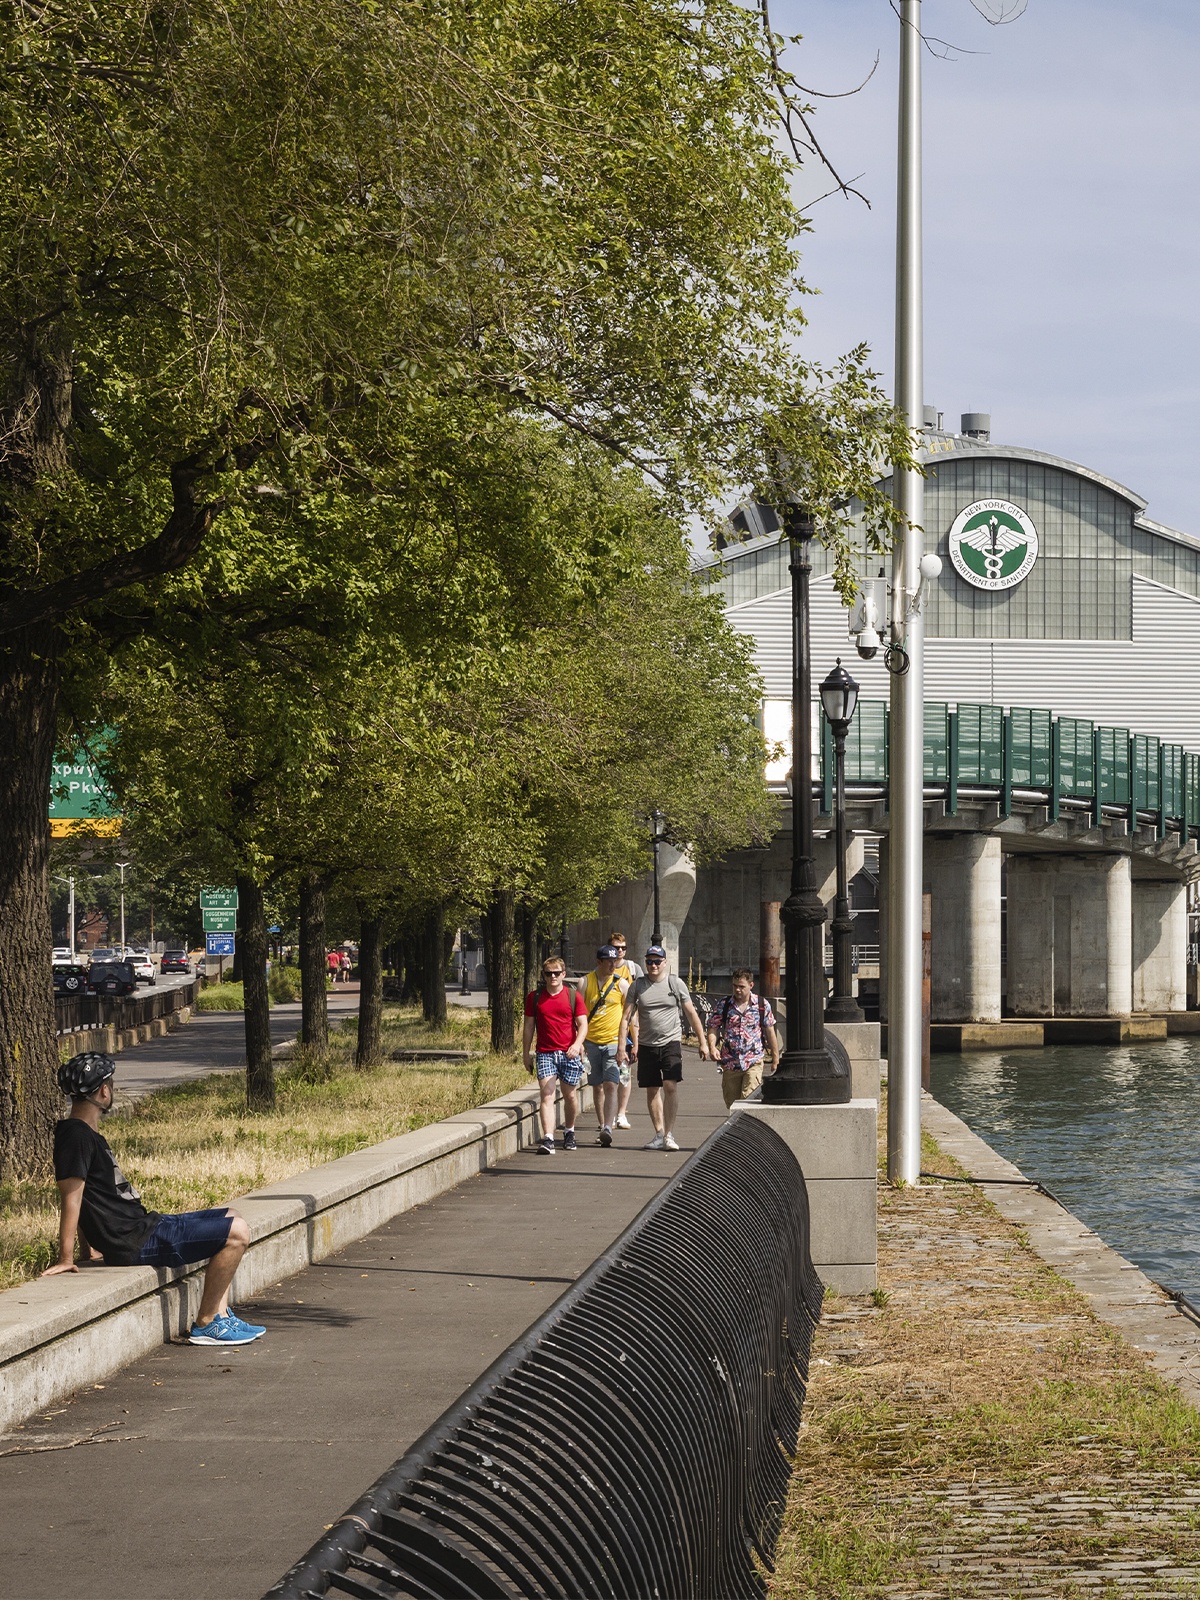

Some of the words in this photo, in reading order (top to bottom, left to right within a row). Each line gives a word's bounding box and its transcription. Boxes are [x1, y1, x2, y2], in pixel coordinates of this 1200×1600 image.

[964, 504, 981, 518] NEW
[983, 501, 1007, 510] YORK
[1007, 506, 1025, 520] CITY
[952, 549, 989, 586] DEPARTMENT
[1001, 551, 1035, 587] SANITATION
[53, 765, 96, 777] xpwy
